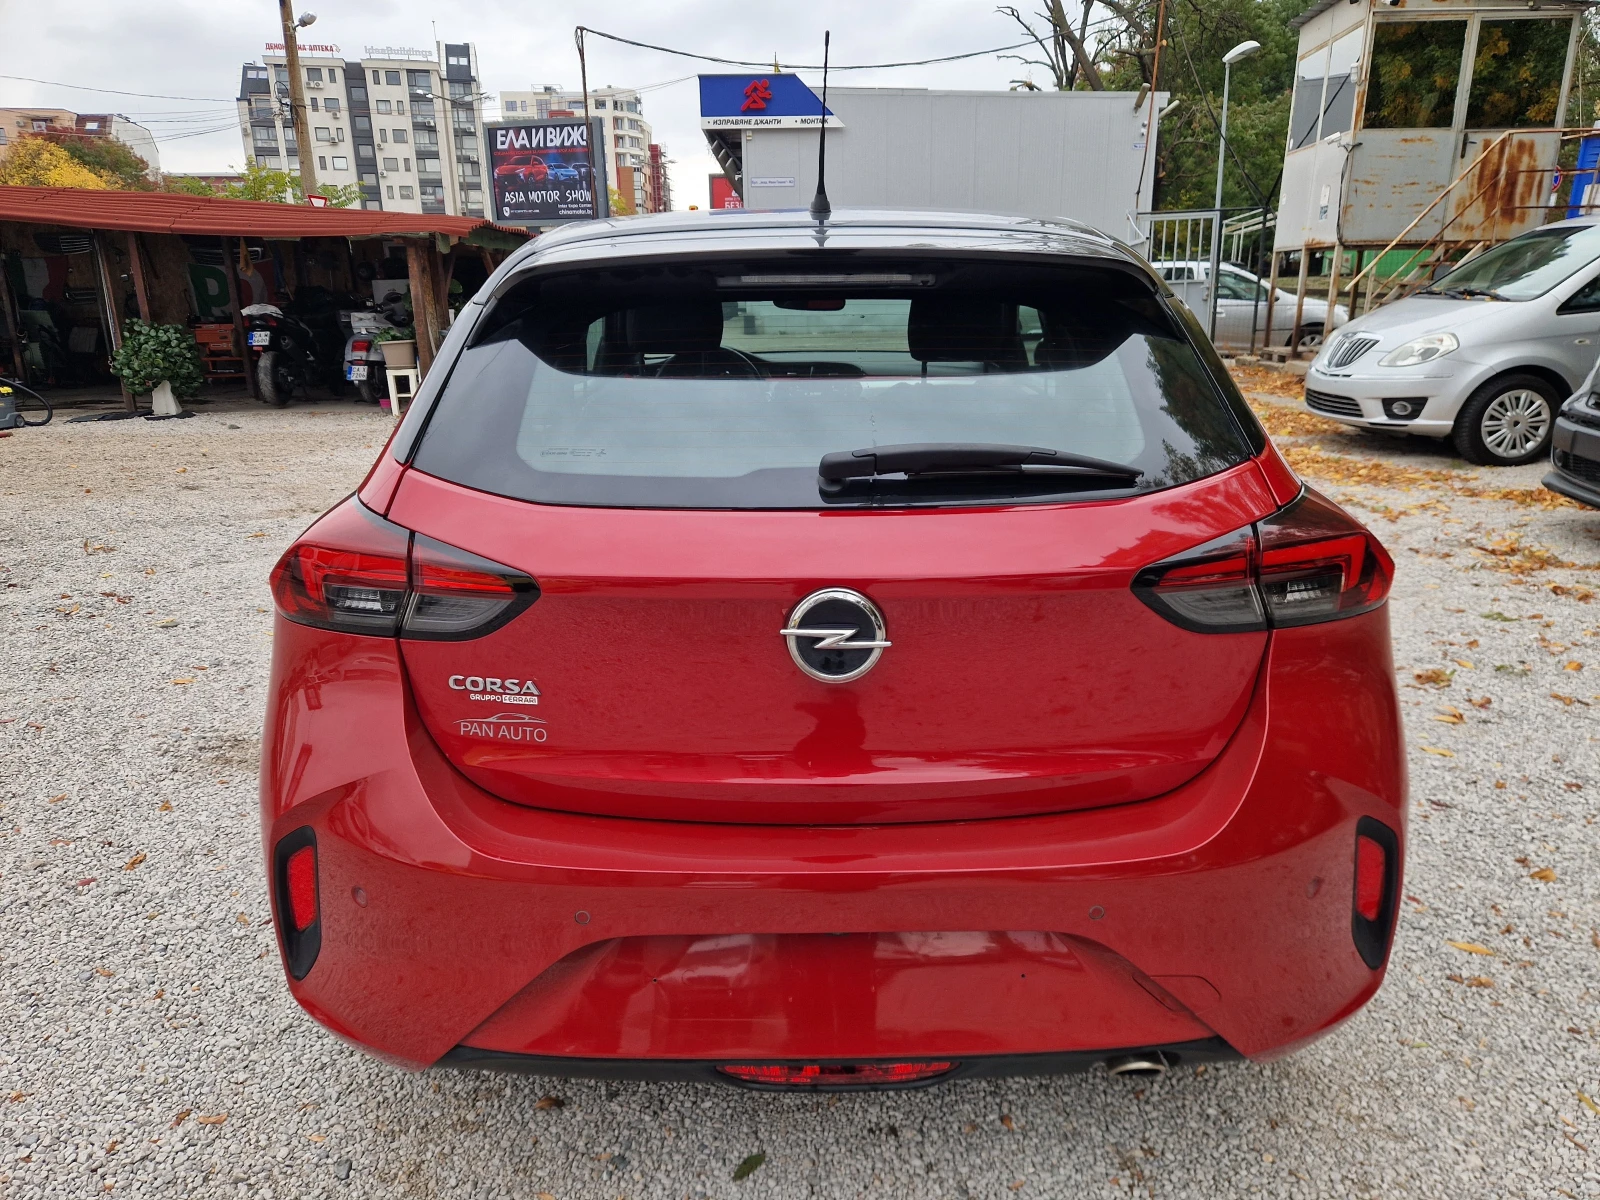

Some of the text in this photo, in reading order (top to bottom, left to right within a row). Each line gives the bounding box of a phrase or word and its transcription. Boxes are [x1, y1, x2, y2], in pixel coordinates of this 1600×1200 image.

[309, 44, 334, 52] АПТЕКА
[712, 118, 782, 126] ИЗПРАВЯНЕ ДЖАНТИ
[496, 129, 530, 150] ЕЛА
[504, 189, 592, 204] ASIA MOTOR SHOW
[448, 675, 541, 695] CORSA
[470, 693, 538, 704] GRUPPO FERRARI
[460, 722, 547, 743] PAN AUTO
